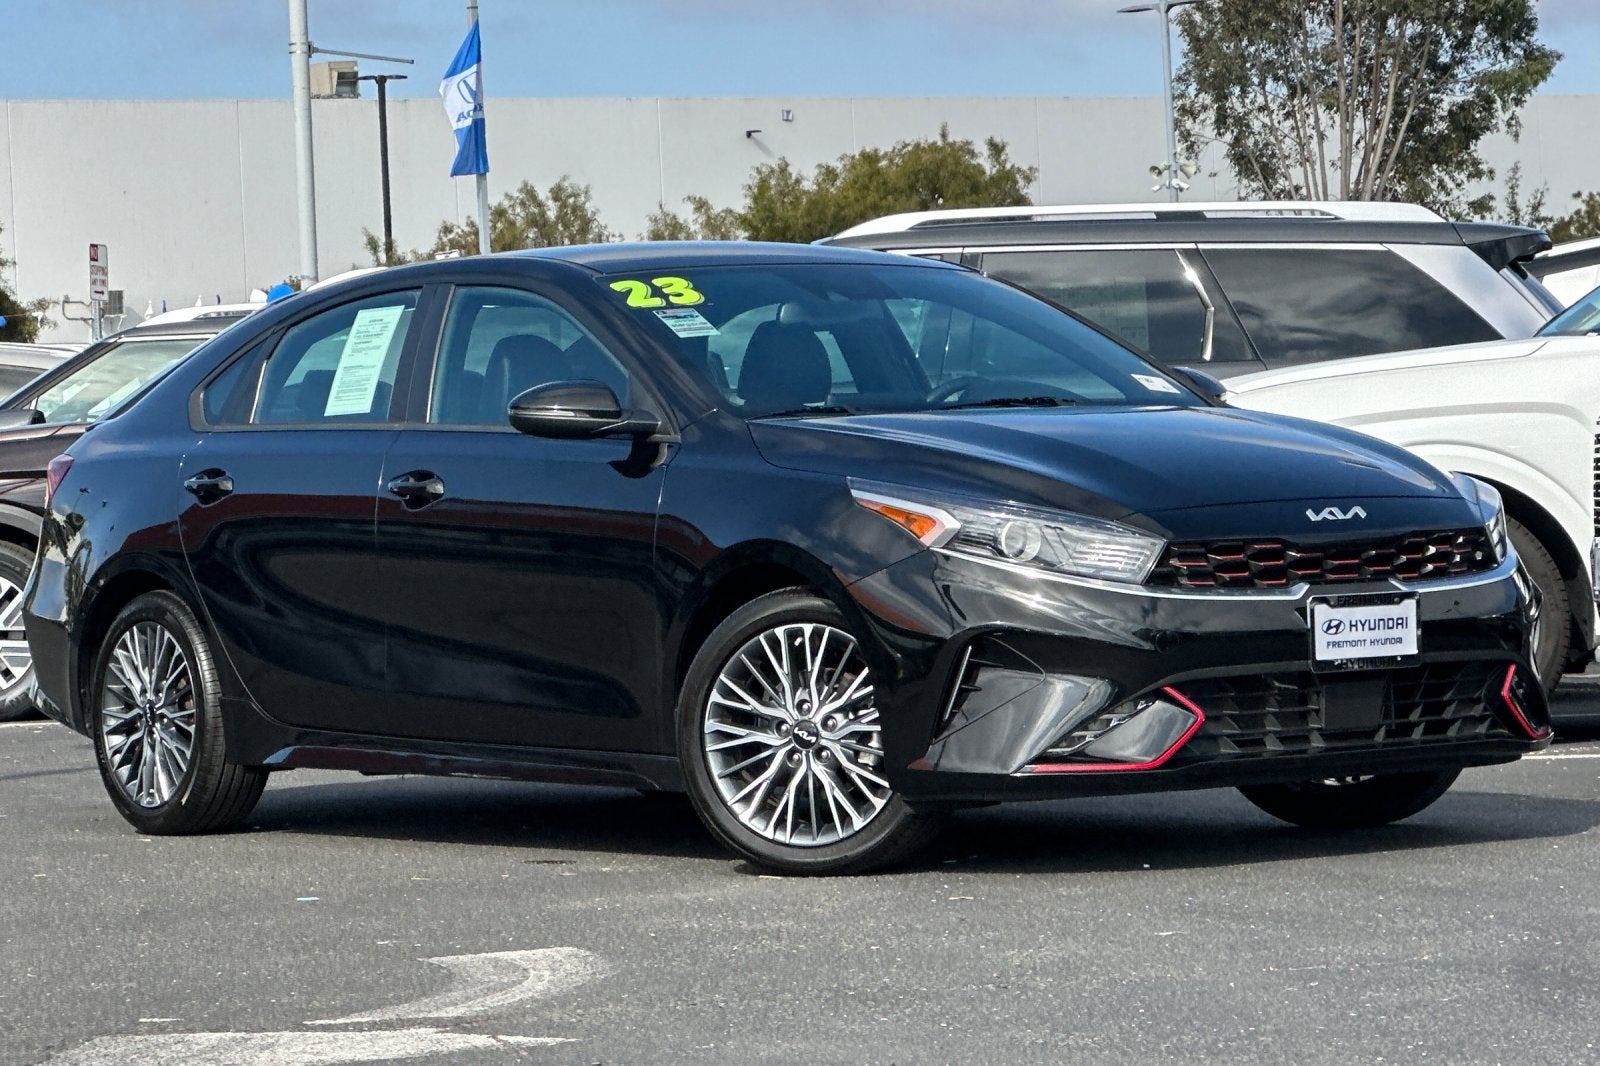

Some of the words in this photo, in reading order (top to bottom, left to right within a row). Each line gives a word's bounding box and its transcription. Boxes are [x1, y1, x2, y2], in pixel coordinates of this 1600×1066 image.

[609, 277, 705, 308] 23
[1306, 506, 1367, 521] KIA
[1349, 617, 1408, 632] HYUNDAI
[1327, 639, 1367, 648] FREMONT
[1370, 637, 1403, 646] HYUNDAI
